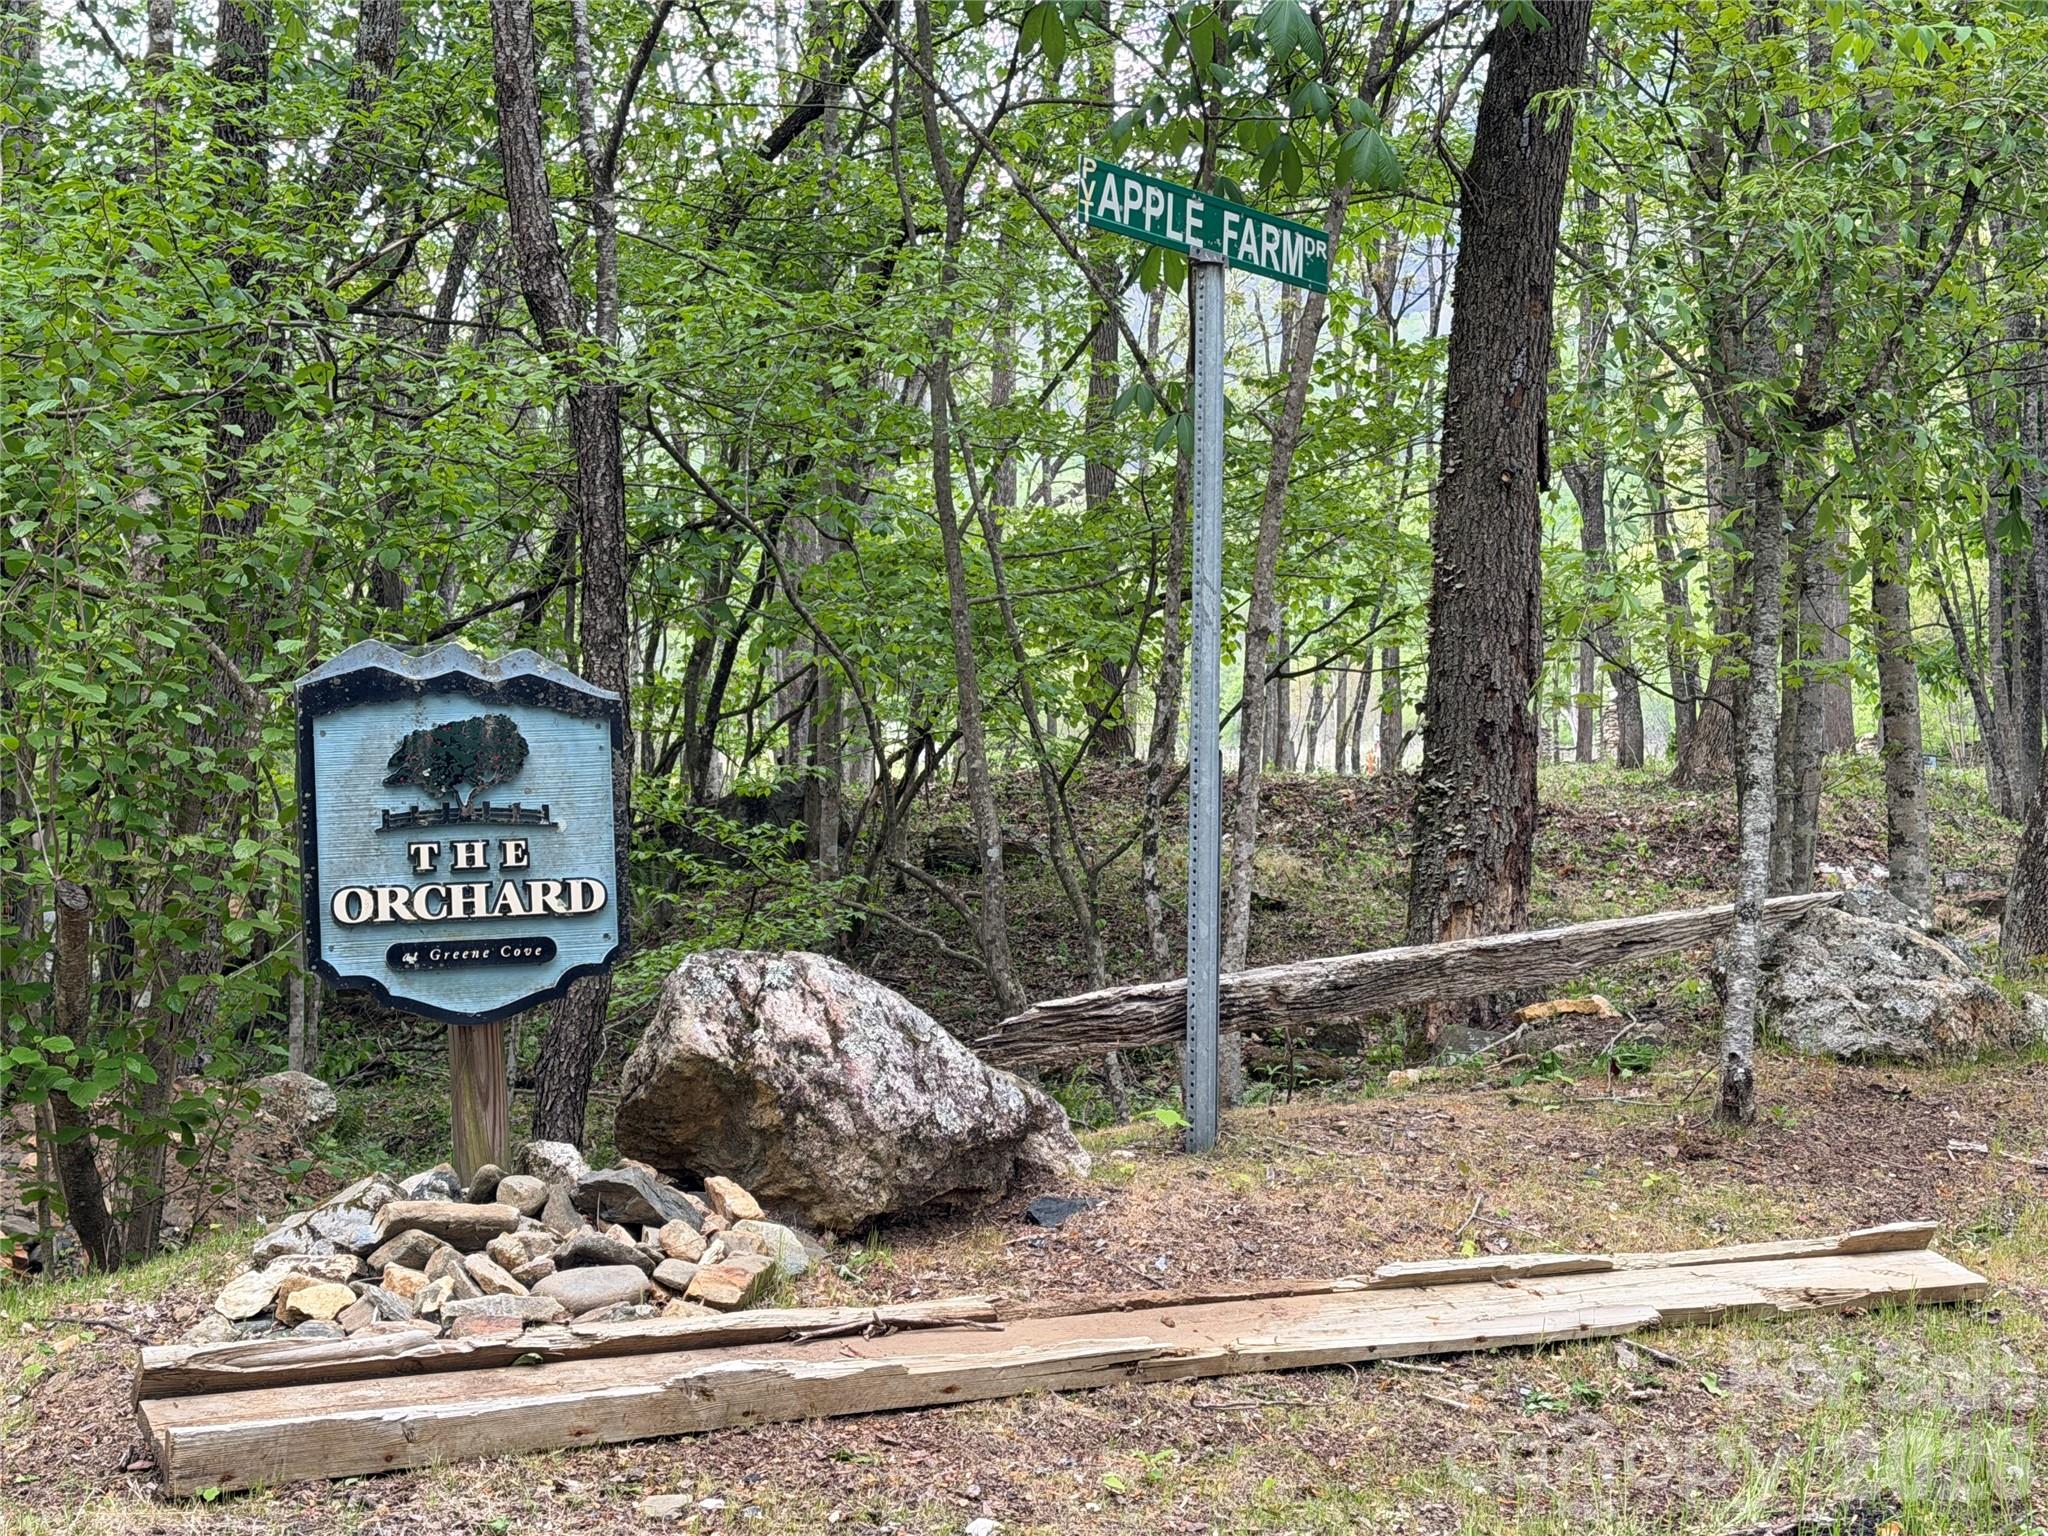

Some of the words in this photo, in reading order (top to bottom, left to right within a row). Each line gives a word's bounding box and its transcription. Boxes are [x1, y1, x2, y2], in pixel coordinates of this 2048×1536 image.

[1080, 157, 1097, 223] PVT
[1097, 172, 1204, 248] APPLE
[1223, 210, 1304, 278] FARM
[1305, 237, 1328, 260] DR
[409, 840, 529, 873] THE
[332, 877, 607, 925] ORCHARD
[429, 948, 491, 962] Greene
[500, 944, 543, 959] Cove
